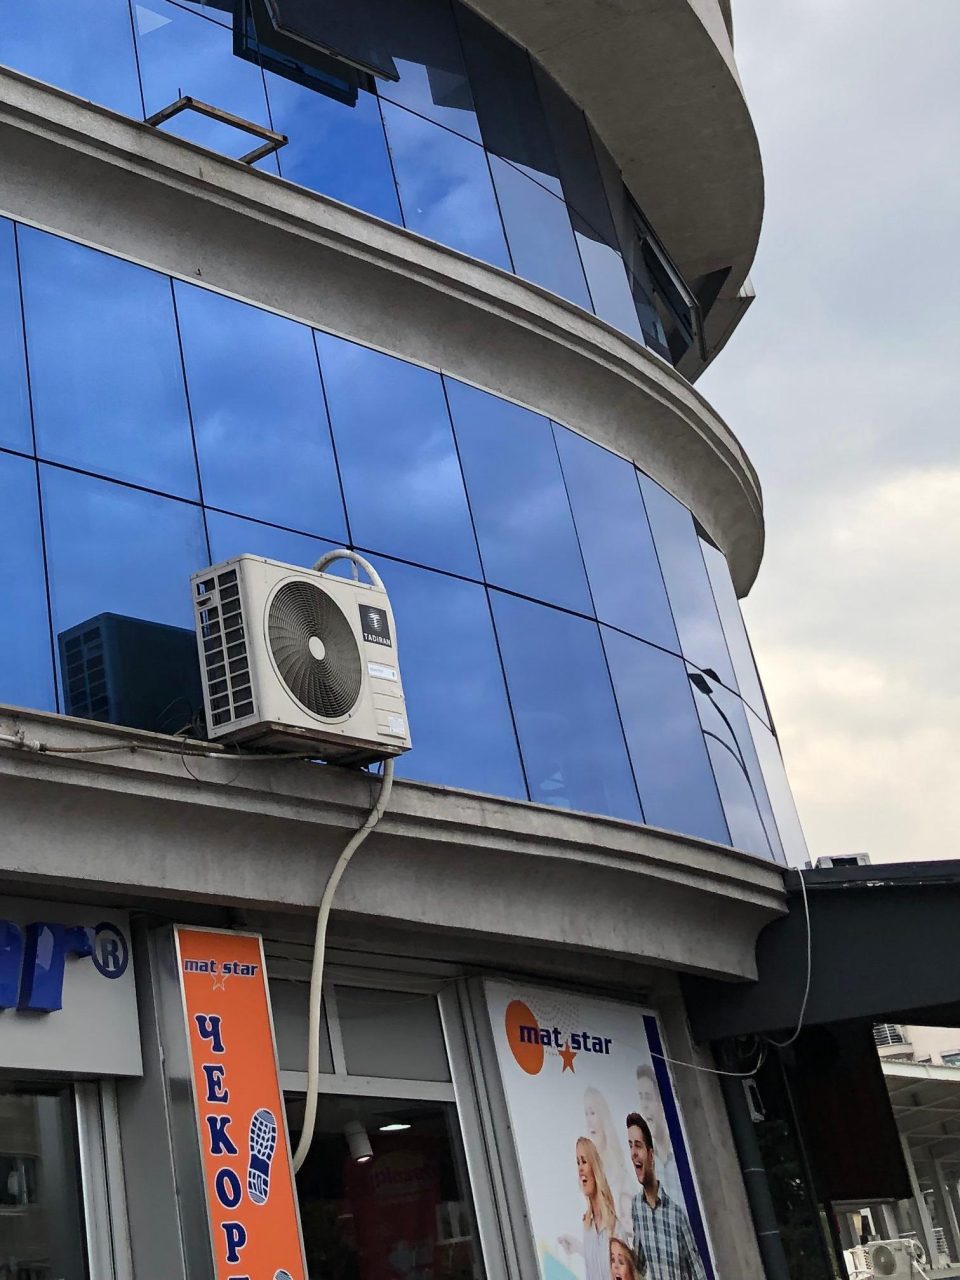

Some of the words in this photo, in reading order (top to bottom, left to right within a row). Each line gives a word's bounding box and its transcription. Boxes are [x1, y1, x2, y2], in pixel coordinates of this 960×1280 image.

[184, 959, 217, 974] mat
[222, 961, 258, 977] star
[519, 1025, 564, 1048] mat
[570, 1031, 613, 1055] star
[194, 1014, 249, 1280] ЧЕКОР
